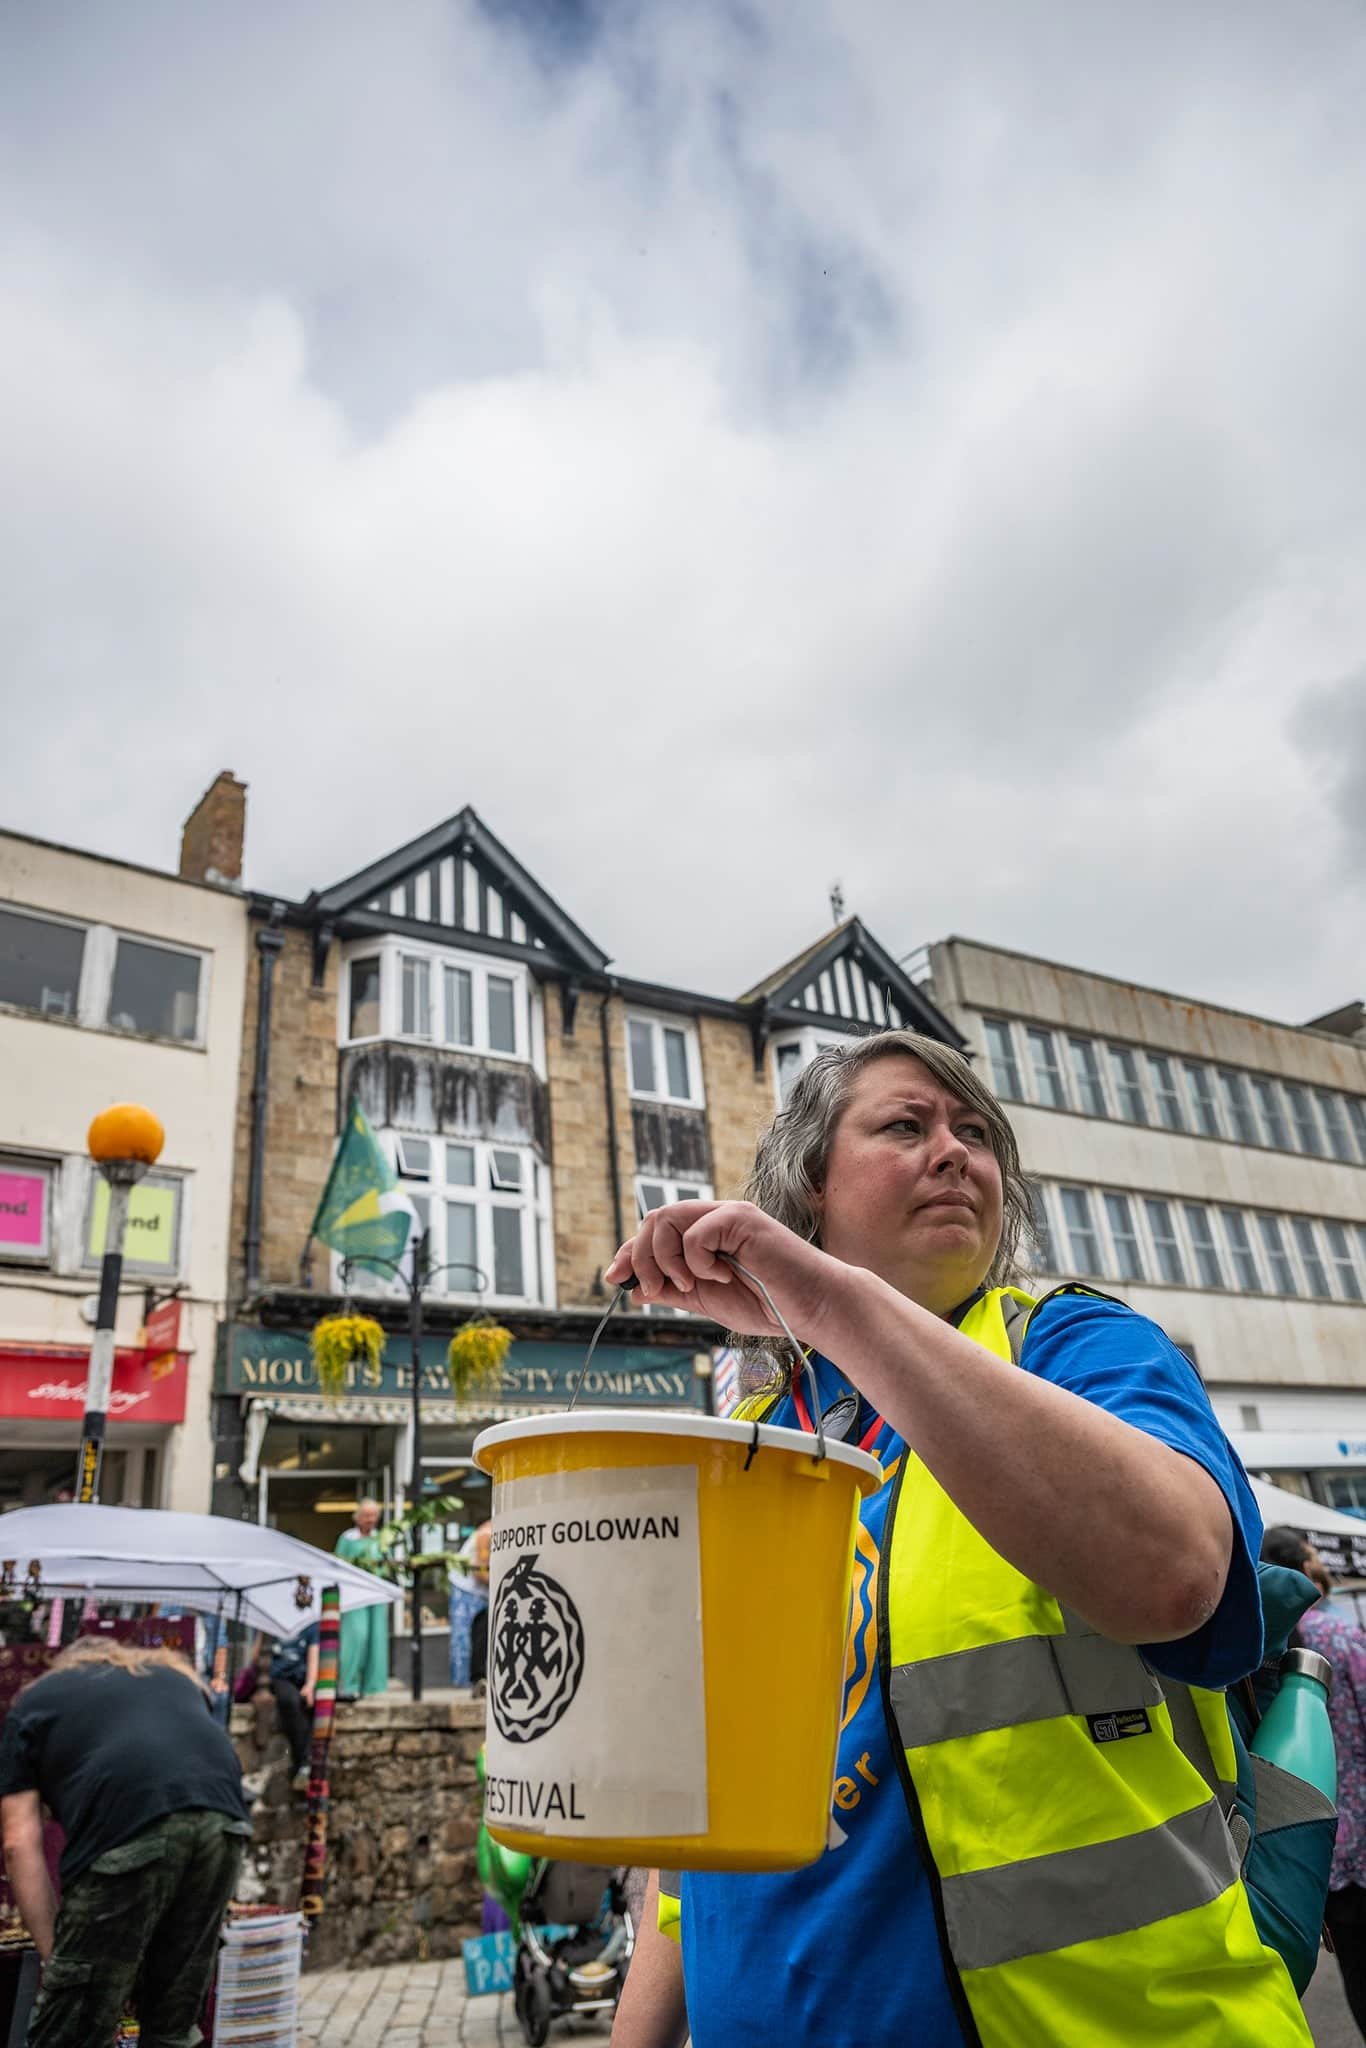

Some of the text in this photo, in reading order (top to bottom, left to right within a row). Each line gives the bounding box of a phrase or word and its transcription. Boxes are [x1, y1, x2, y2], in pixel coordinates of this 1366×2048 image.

[241, 1357, 382, 1388] MOUTS
[565, 1370, 687, 1396] COMPANY
[492, 1523, 547, 1552] SUPPORT
[551, 1515, 680, 1545] GOLOWAN
